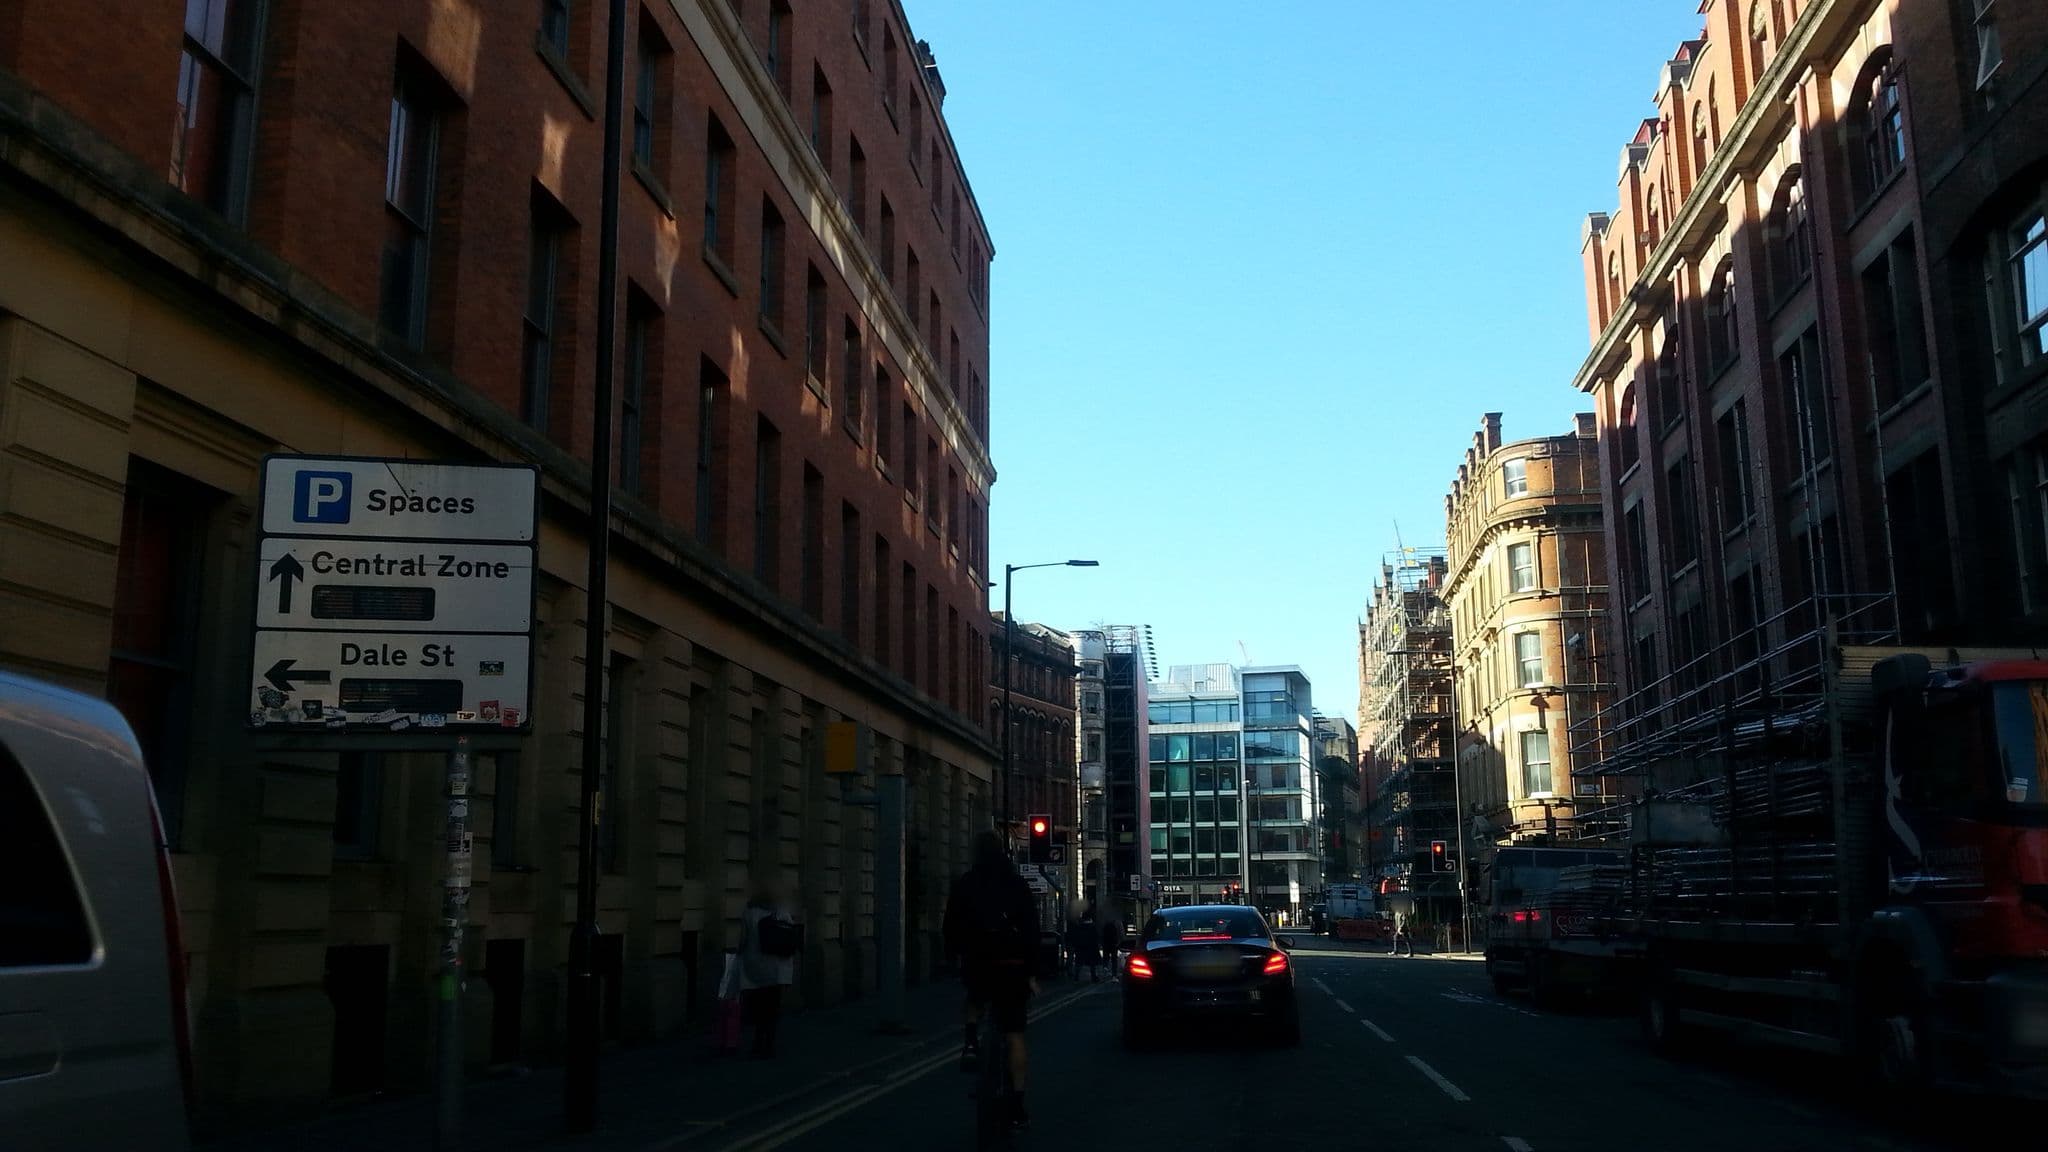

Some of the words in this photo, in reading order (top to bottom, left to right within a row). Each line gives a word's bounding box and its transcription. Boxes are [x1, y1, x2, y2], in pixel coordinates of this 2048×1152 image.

[308, 477, 344, 518] P
[366, 488, 475, 516] Spaces
[311, 551, 425, 577] Central
[437, 555, 510, 579] Zone
[340, 643, 408, 667] Dale
[420, 644, 455, 668] St
